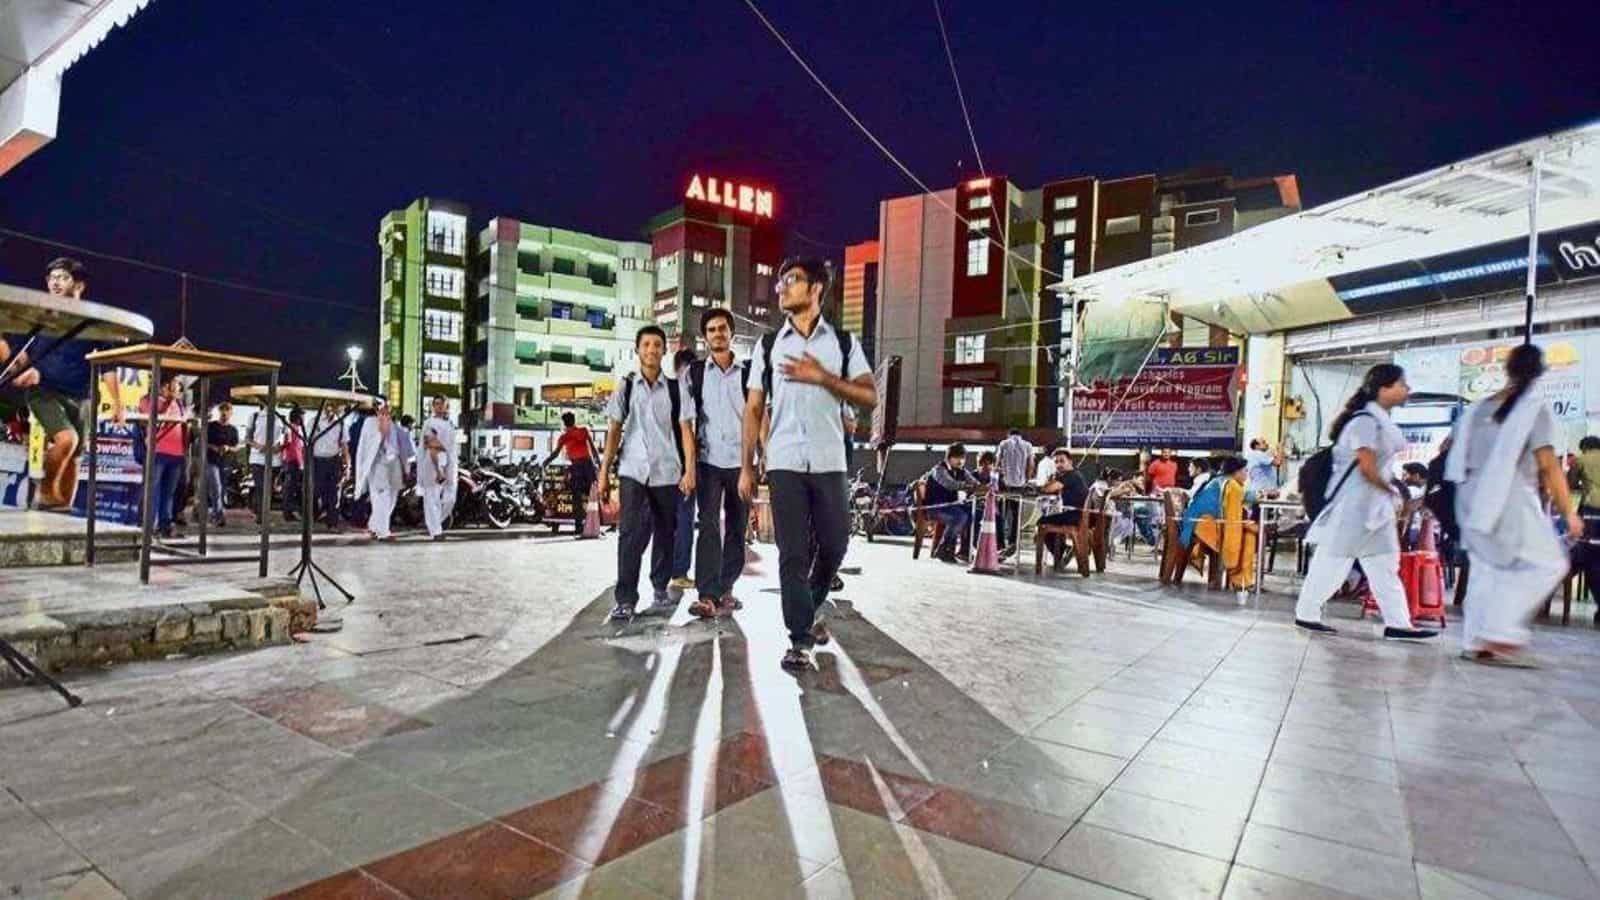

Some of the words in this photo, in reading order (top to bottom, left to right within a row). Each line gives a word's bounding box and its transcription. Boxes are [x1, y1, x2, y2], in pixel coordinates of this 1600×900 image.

[685, 174, 773, 218] ALLEN
[1175, 383, 1223, 398] Program
[1074, 397, 1105, 409] May
[1149, 401, 1185, 410] Course
